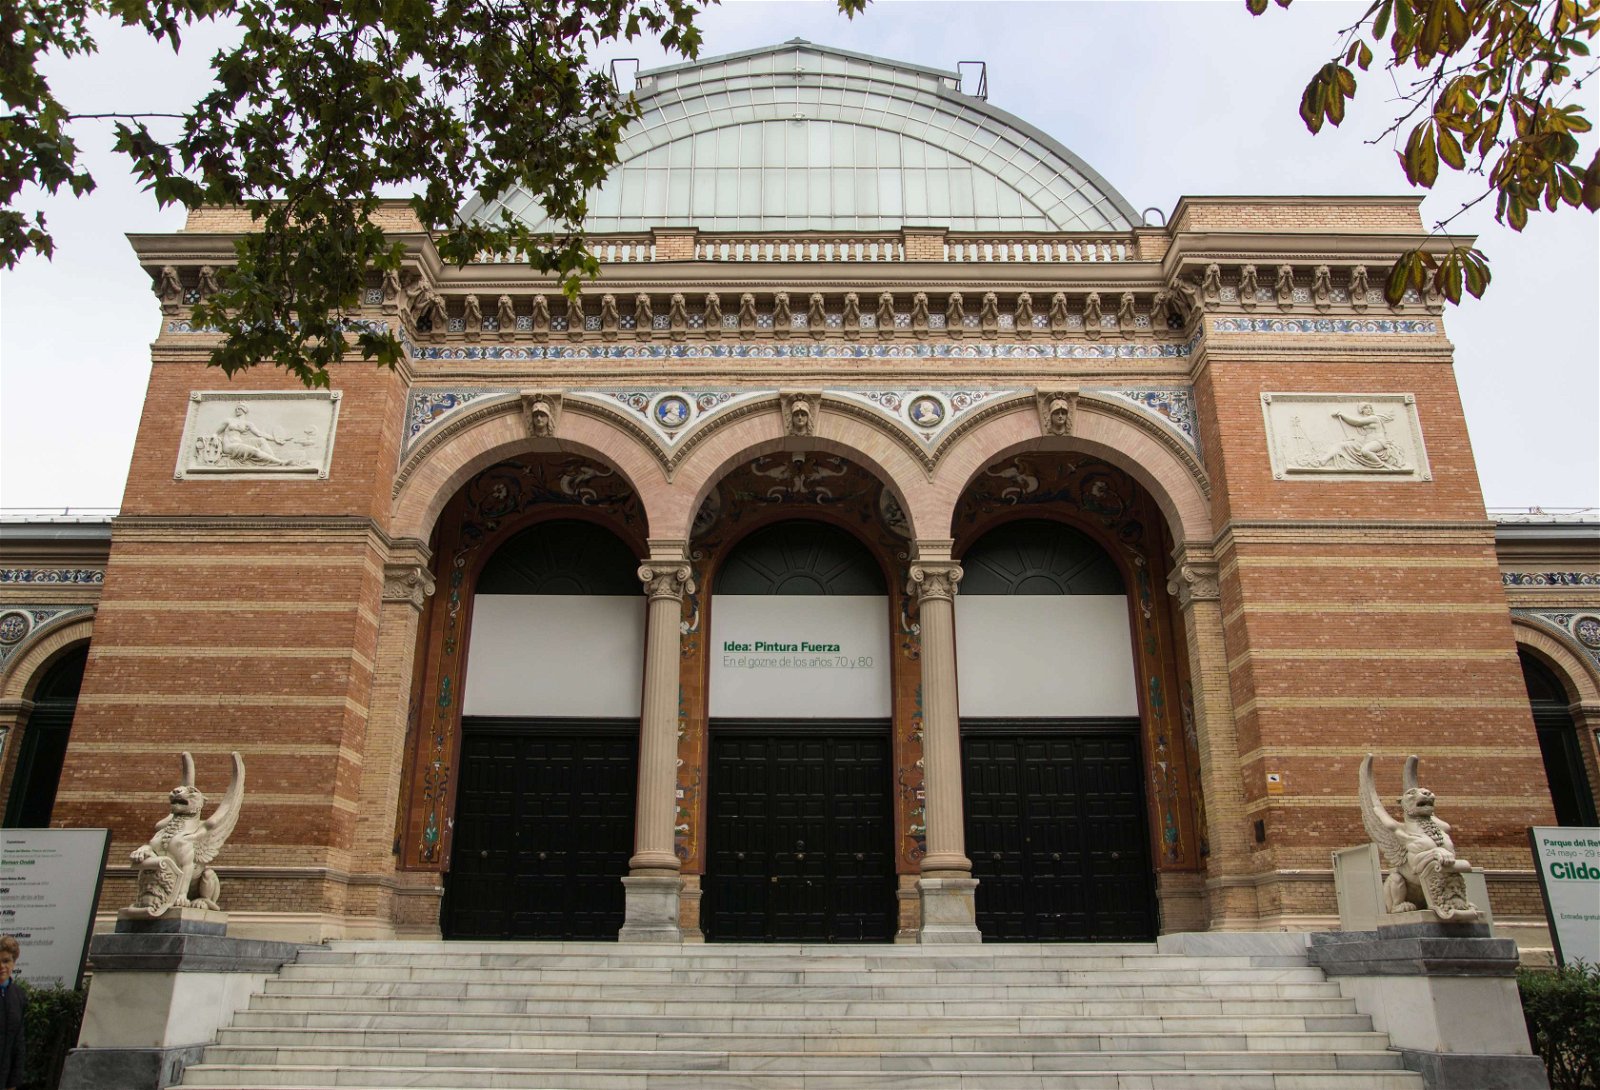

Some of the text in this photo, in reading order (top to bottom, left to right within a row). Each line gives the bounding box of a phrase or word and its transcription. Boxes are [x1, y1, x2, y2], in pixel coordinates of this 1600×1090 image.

[723, 641, 840, 652] Idea: Pintura Fuerza
[723, 656, 873, 669] En el gozne de los años 70 y 80
[1543, 838, 1572, 848] Parque
[1574, 839, 1586, 847] del
[1545, 848, 1556, 857] 24
[1557, 850, 1578, 858] mayo
[1584, 849, 1595, 857] 29
[1550, 861, 1600, 880] Cildo
[1560, 912, 1583, 920] Entrada
